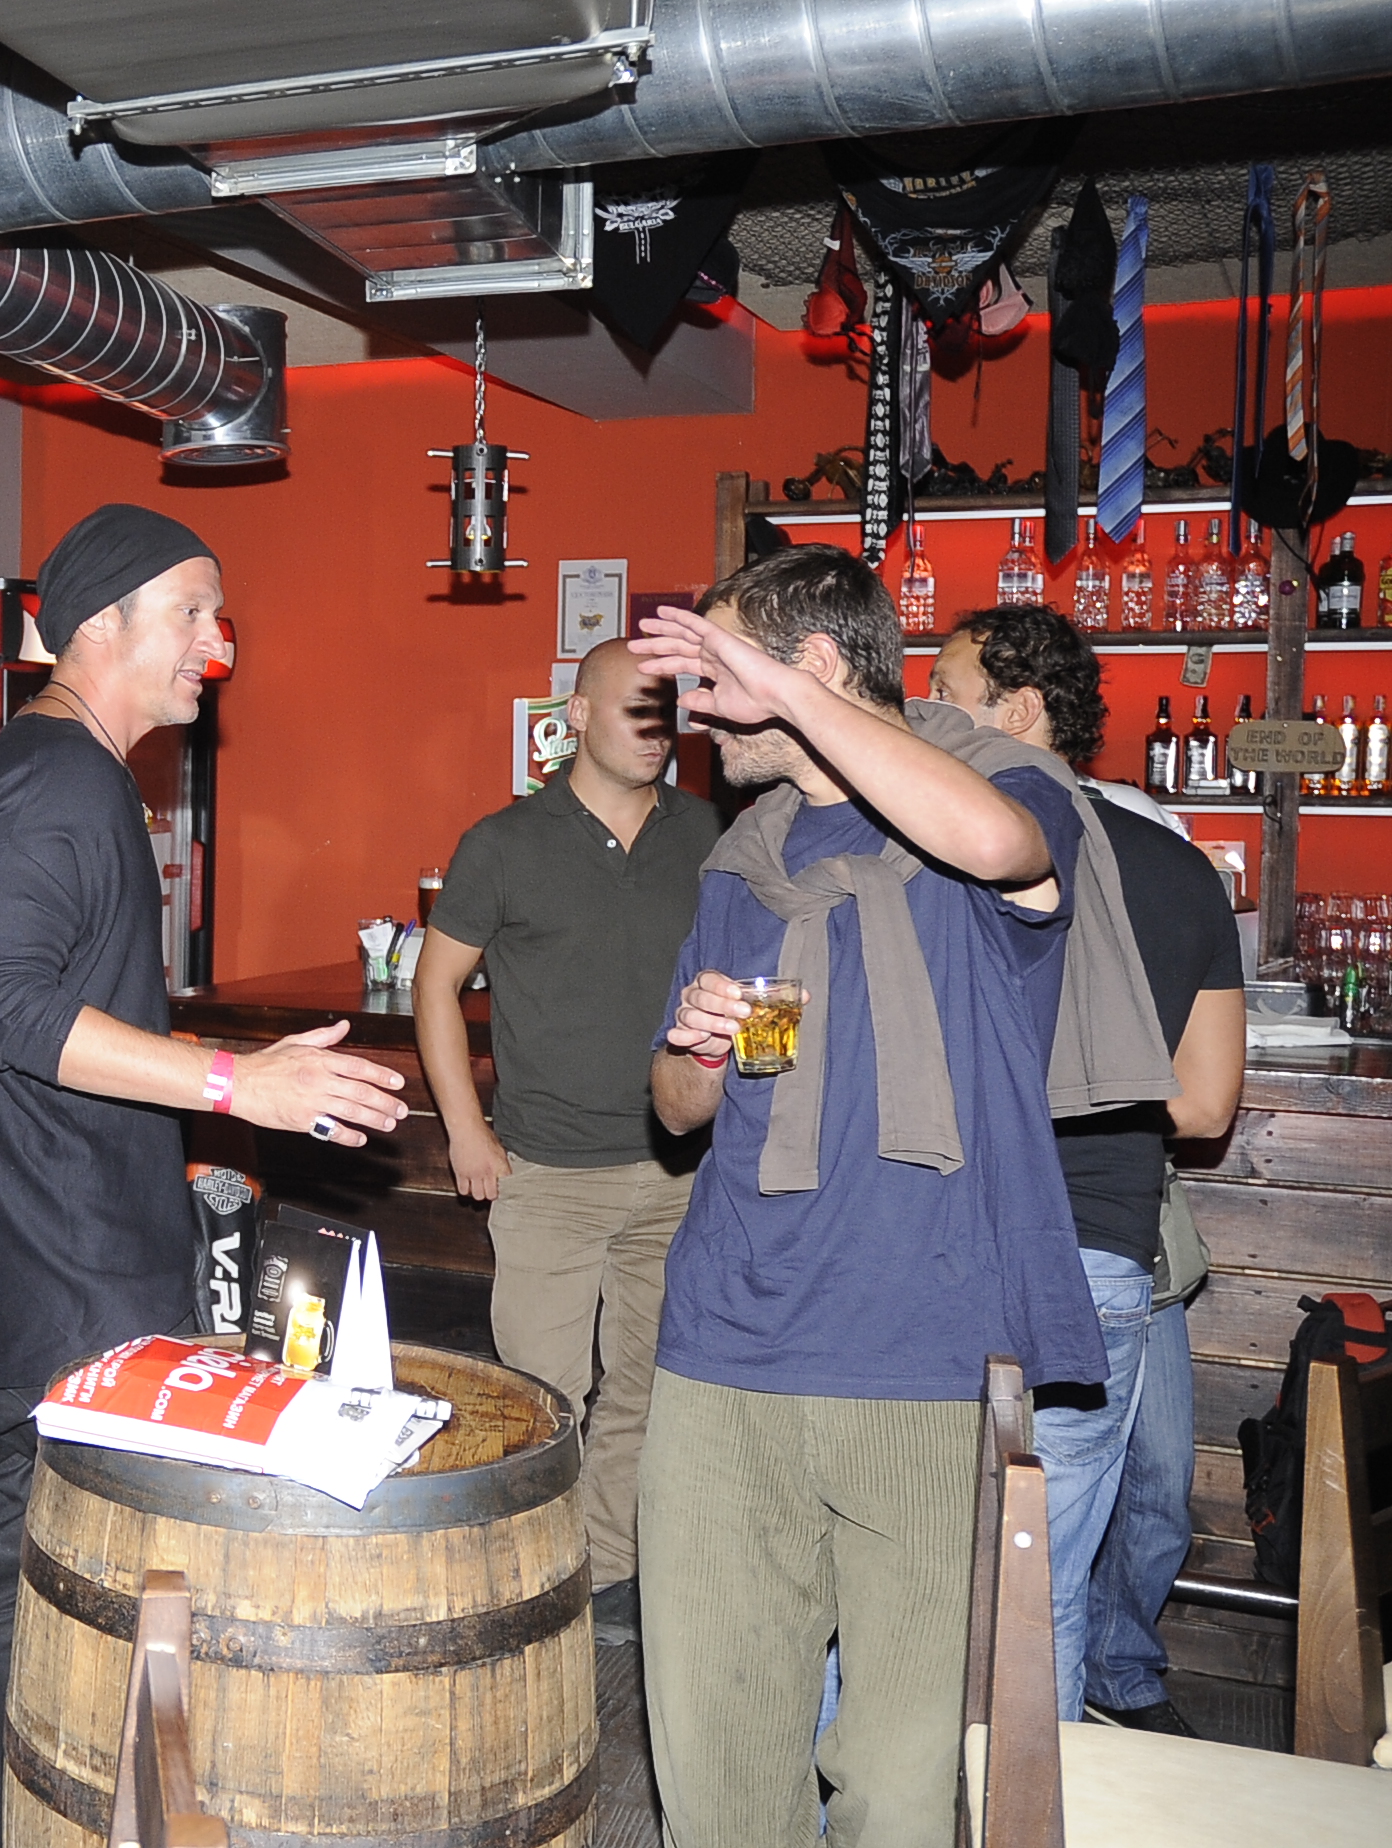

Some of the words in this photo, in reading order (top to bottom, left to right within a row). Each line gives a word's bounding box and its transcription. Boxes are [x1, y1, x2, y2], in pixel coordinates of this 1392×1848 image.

[1246, 729, 1286, 745] END
[1299, 731, 1324, 746] OF
[1230, 747, 1269, 762] THE
[1275, 749, 1345, 765] WORLD
